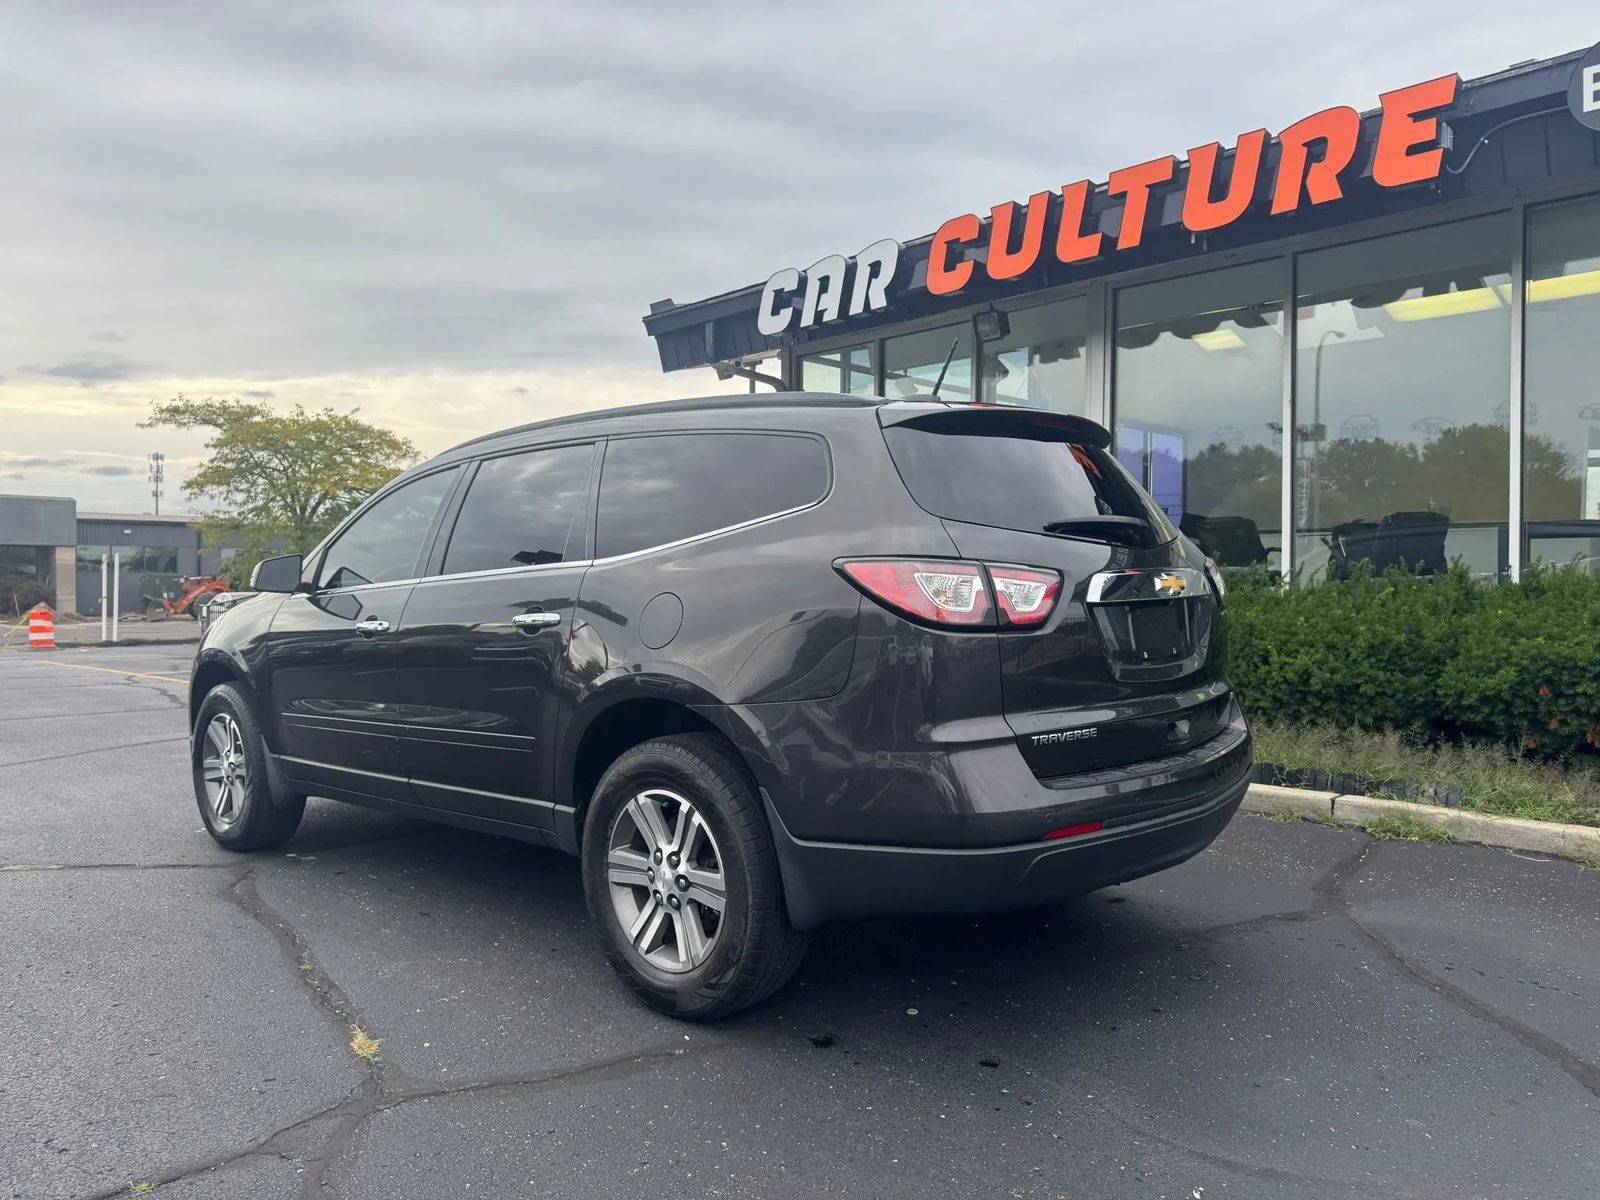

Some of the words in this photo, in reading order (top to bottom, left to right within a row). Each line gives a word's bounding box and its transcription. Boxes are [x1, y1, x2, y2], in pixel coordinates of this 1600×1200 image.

[757, 238, 900, 336] CAR
[926, 73, 1458, 295] CULTURE
[1031, 727, 1098, 747] TRAVERSE
